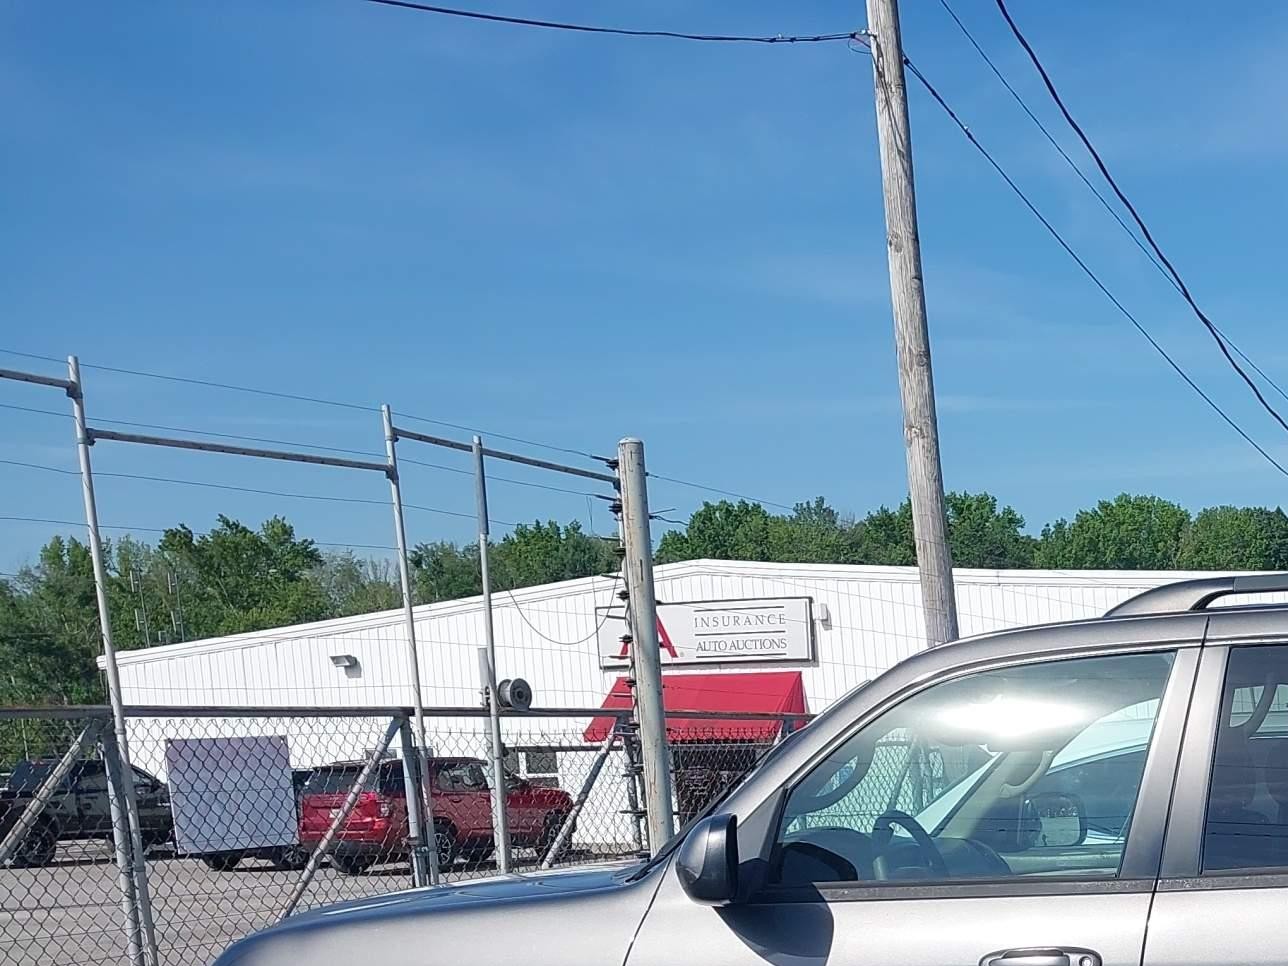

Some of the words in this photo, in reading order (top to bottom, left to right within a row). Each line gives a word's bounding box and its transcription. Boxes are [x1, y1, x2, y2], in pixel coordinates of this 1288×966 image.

[694, 613, 786, 628] INSURANCE
[696, 641, 727, 651] AUTO
[729, 638, 787, 650] AUCTIONS
